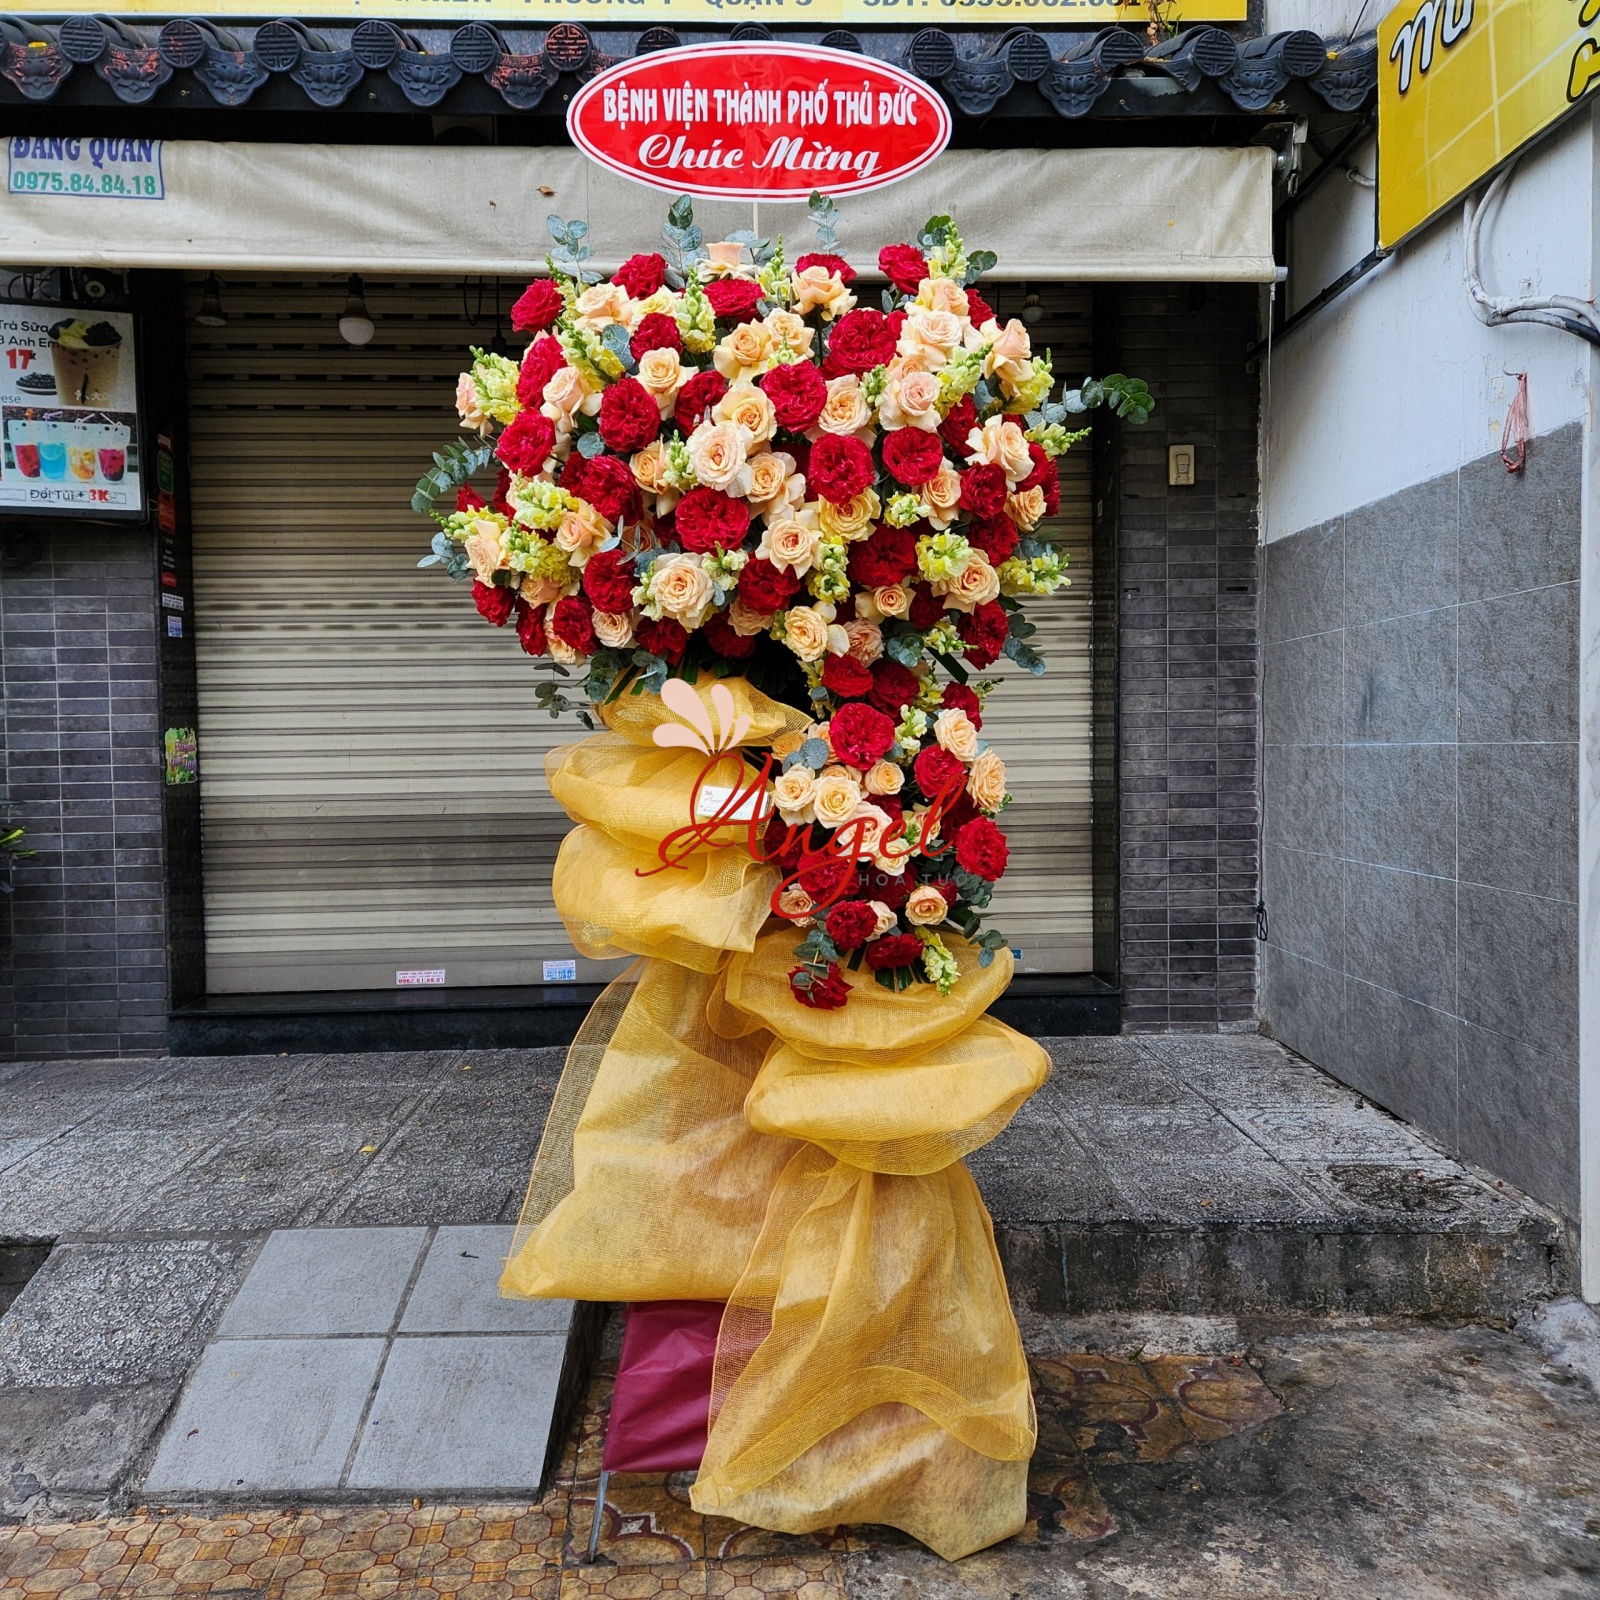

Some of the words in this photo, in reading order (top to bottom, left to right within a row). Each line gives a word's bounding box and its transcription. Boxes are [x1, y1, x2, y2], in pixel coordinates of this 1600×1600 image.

[603, 81, 658, 130] BỆNH
[662, 81, 708, 130] VIỆN
[713, 81, 781, 127] THÀNH
[787, 78, 829, 126] PHỐ
[833, 80, 872, 128] THỦ
[878, 83, 917, 127] ĐỨC
[638, 134, 745, 170] Chúc
[752, 135, 883, 178] Mừng
[13, 171, 156, 195] 0975.84.84.18
[21, 320, 49, 333] Sữa
[8, 335, 36, 347] Anh
[38, 337, 60, 348] Em
[0, 394, 21, 404] ese
